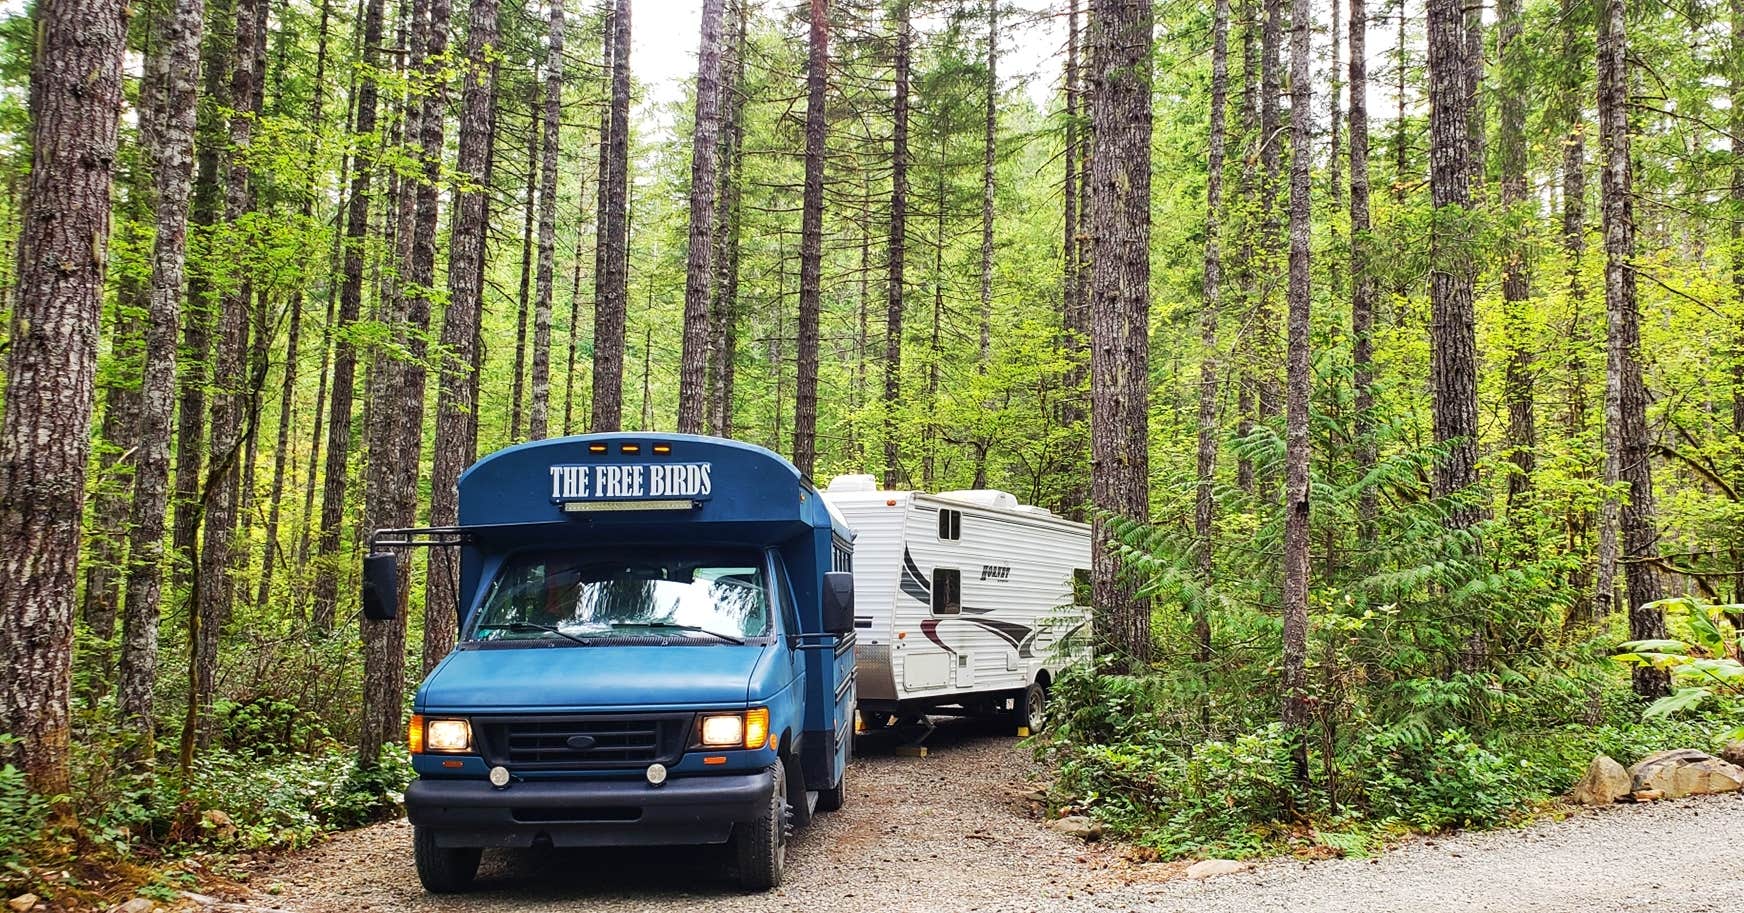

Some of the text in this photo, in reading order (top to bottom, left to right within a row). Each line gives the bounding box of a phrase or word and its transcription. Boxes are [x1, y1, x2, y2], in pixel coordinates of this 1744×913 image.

[550, 463, 712, 497] THE FREE BIRDS
